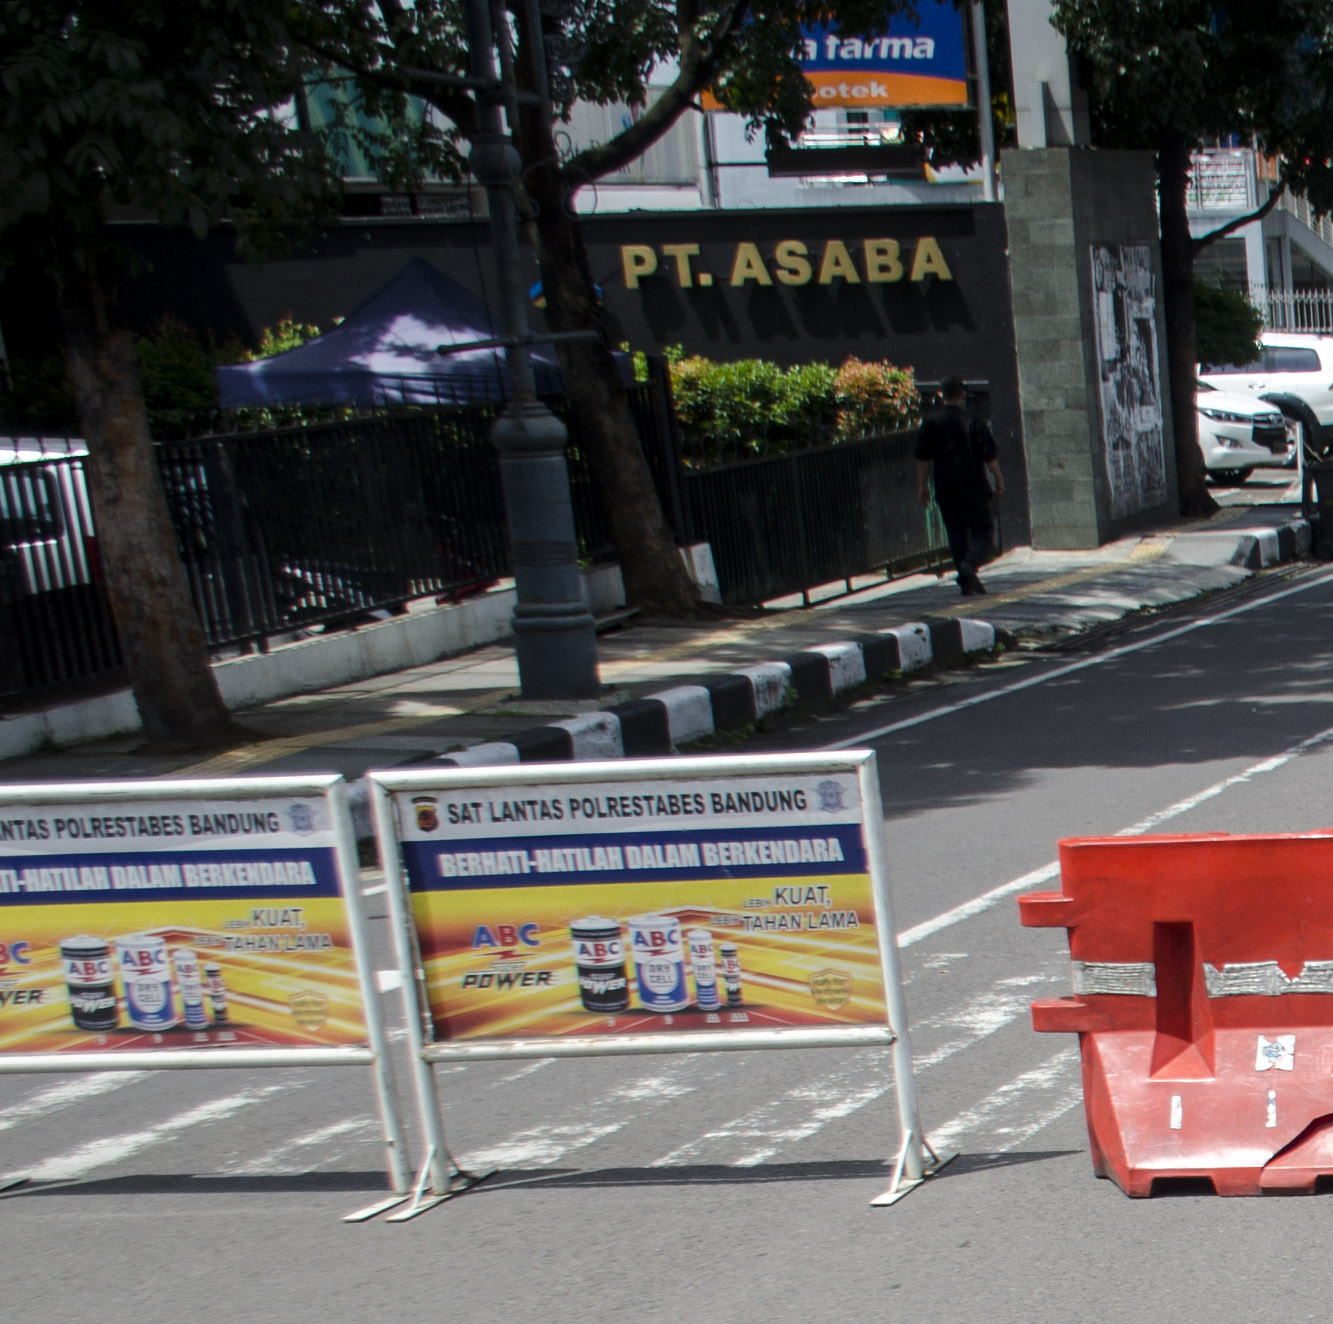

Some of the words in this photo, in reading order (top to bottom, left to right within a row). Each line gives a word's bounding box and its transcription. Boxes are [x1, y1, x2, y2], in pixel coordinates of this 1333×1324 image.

[620, 243, 713, 289] PT.
[731, 236, 953, 287] ASABA
[447, 802, 483, 825] SAT
[487, 799, 565, 823] LANTAS
[568, 792, 705, 819] POLRESTABES
[710, 789, 808, 815] BANDUNG
[54, 814, 184, 839] POLRESTABES
[188, 812, 280, 835] BANDUNG
[438, 846, 625, 877] BERHATI-HATILAH
[625, 843, 701, 869] DALAM
[701, 838, 845, 867] BERKENDARA
[110, 863, 184, 889] DALAM
[182, 861, 317, 887] BERKENDARA
[774, 885, 833, 909] KUAT,
[251, 907, 306, 930] KUAT,
[742, 912, 805, 932] TAHAN
[806, 910, 860, 930] LAMA
[224, 936, 283, 952] TAHAN
[285, 934, 333, 951] LAMA
[472, 923, 541, 948] ABC
[633, 930, 679, 948] ABC
[122, 949, 164, 967] ABC
[577, 942, 621, 957] ABC
[69, 960, 108, 975] ABC
[461, 971, 553, 992] POWER
